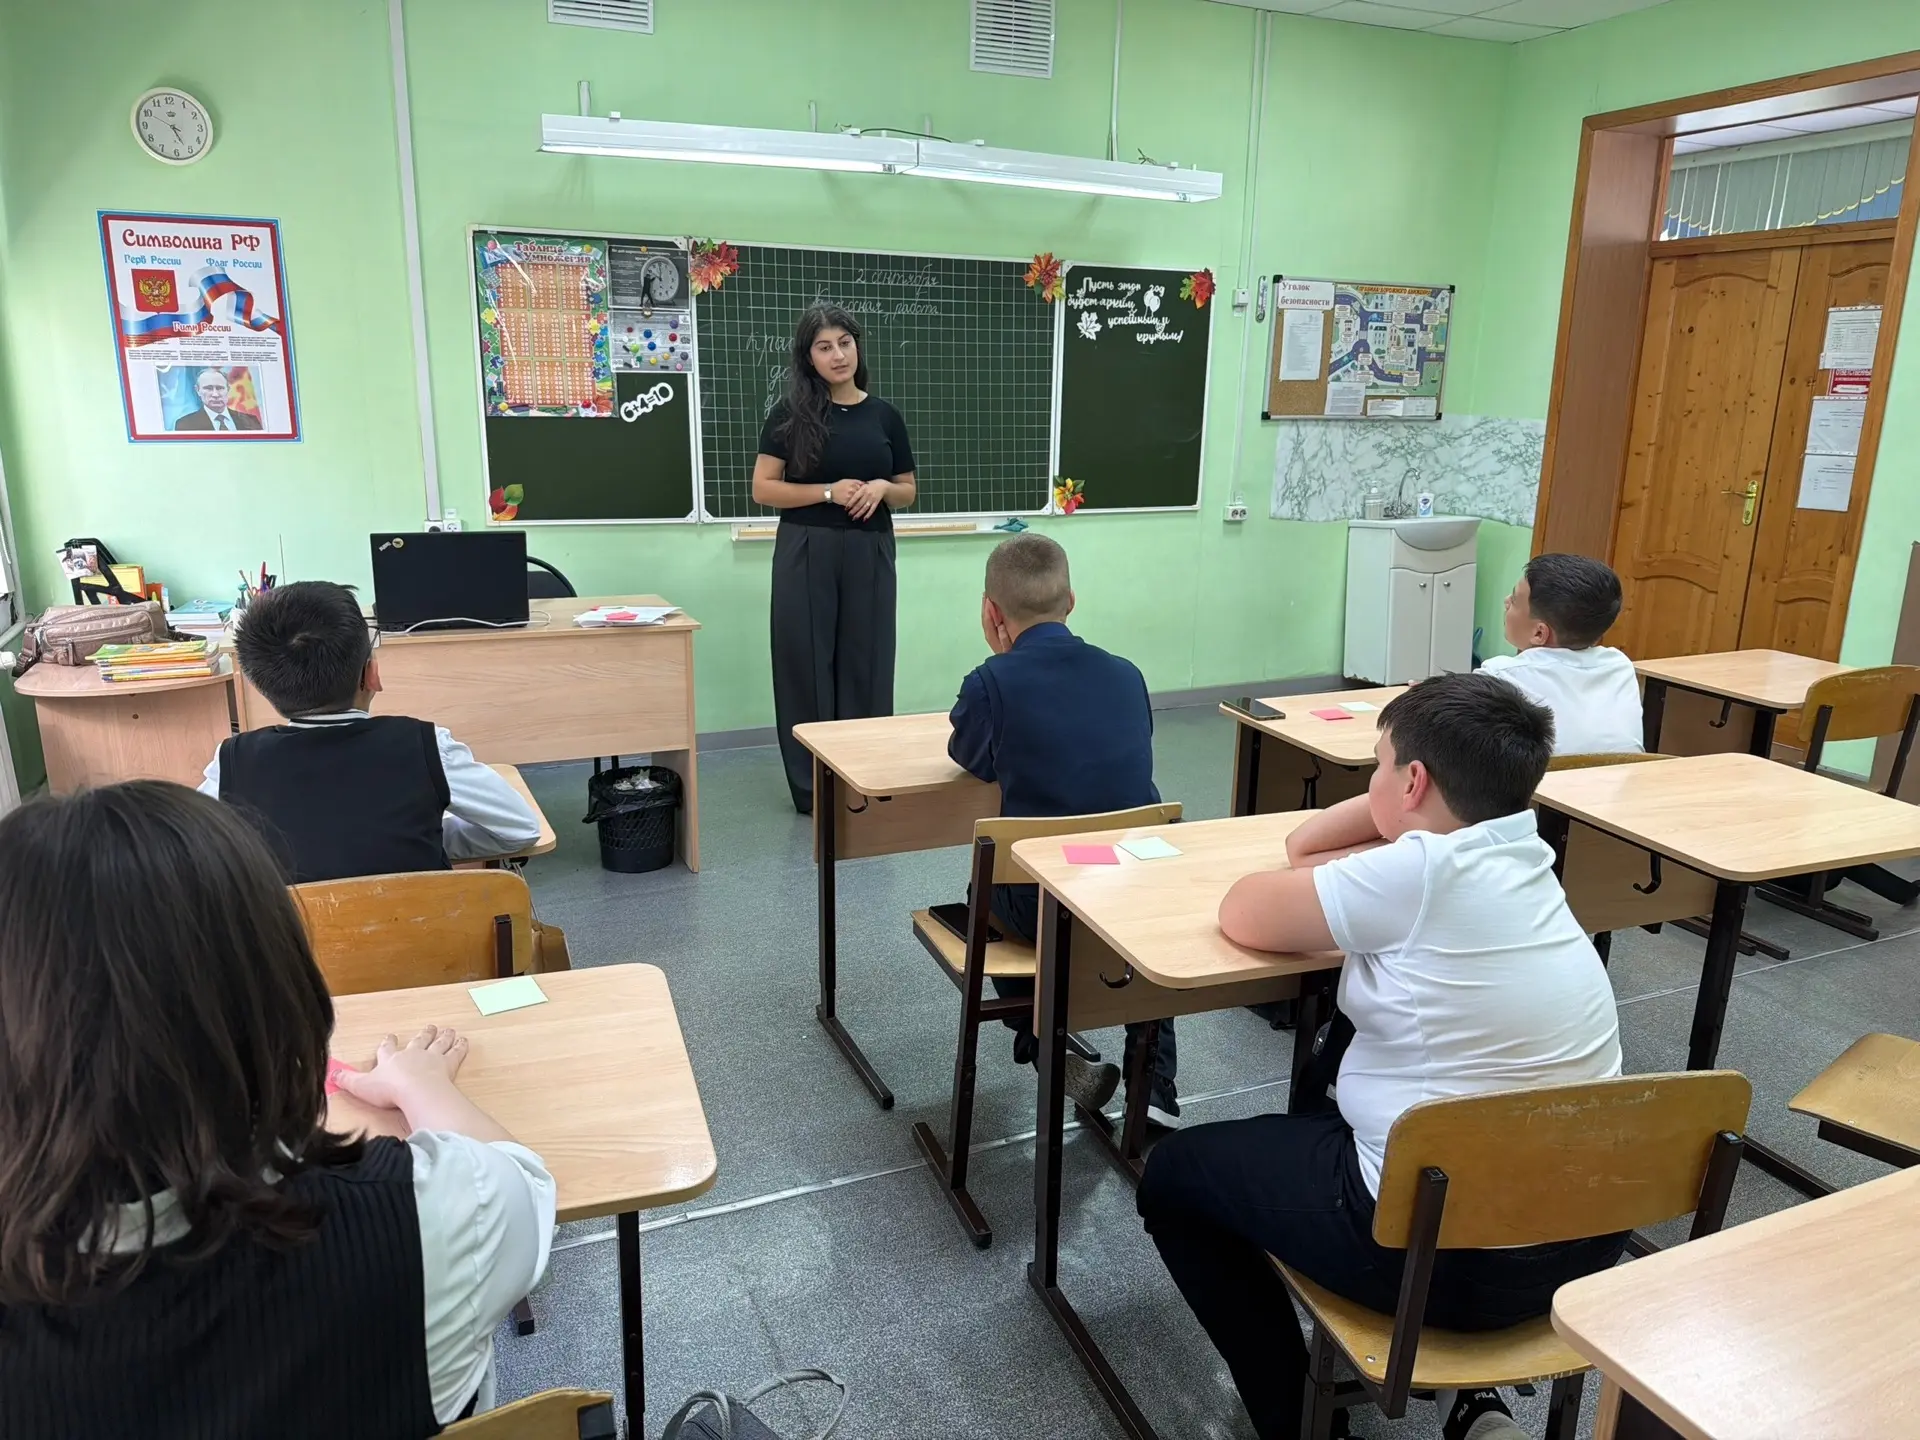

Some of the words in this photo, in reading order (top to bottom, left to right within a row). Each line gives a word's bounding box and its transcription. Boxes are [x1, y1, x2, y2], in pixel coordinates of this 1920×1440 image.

[152, 98, 161, 108] 11
[164, 96, 175, 105] 12
[181, 100, 187, 109] 1
[143, 108, 153, 118] 10
[191, 111, 198, 120] 2
[141, 121, 149, 130] 9
[197, 123, 204, 133] 3
[147, 133, 155, 142] 8
[195, 136, 202, 145] 4
[158, 143, 165, 153] 7
[173, 148, 180, 157] 6
[187, 145, 194, 154] 5
[122, 228, 223, 250] Символика
[231, 231, 260, 251] РФ
[515, 242, 564, 254] Таблица
[124, 254, 147, 266] Герб
[150, 255, 182, 265] России
[205, 257, 229, 267] Флаг
[232, 258, 262, 268] России
[855, 268, 867, 284] 2
[871, 264, 940, 292] сентября
[1082, 276, 1115, 294] Пусть
[1148, 284, 1166, 298] год
[1281, 282, 1311, 291] Уголок
[1067, 293, 1098, 309] будет
[1280, 295, 1330, 306] безопасности
[1108, 315, 1160, 329] успешным
[1162, 316, 1171, 325] и
[173, 322, 198, 332] Гимн
[201, 323, 231, 333] России
[1136, 330, 1184, 344] крутым!
[621, 383, 673, 422] 6+4=10
[1474, 1391, 1497, 1400] FILA
